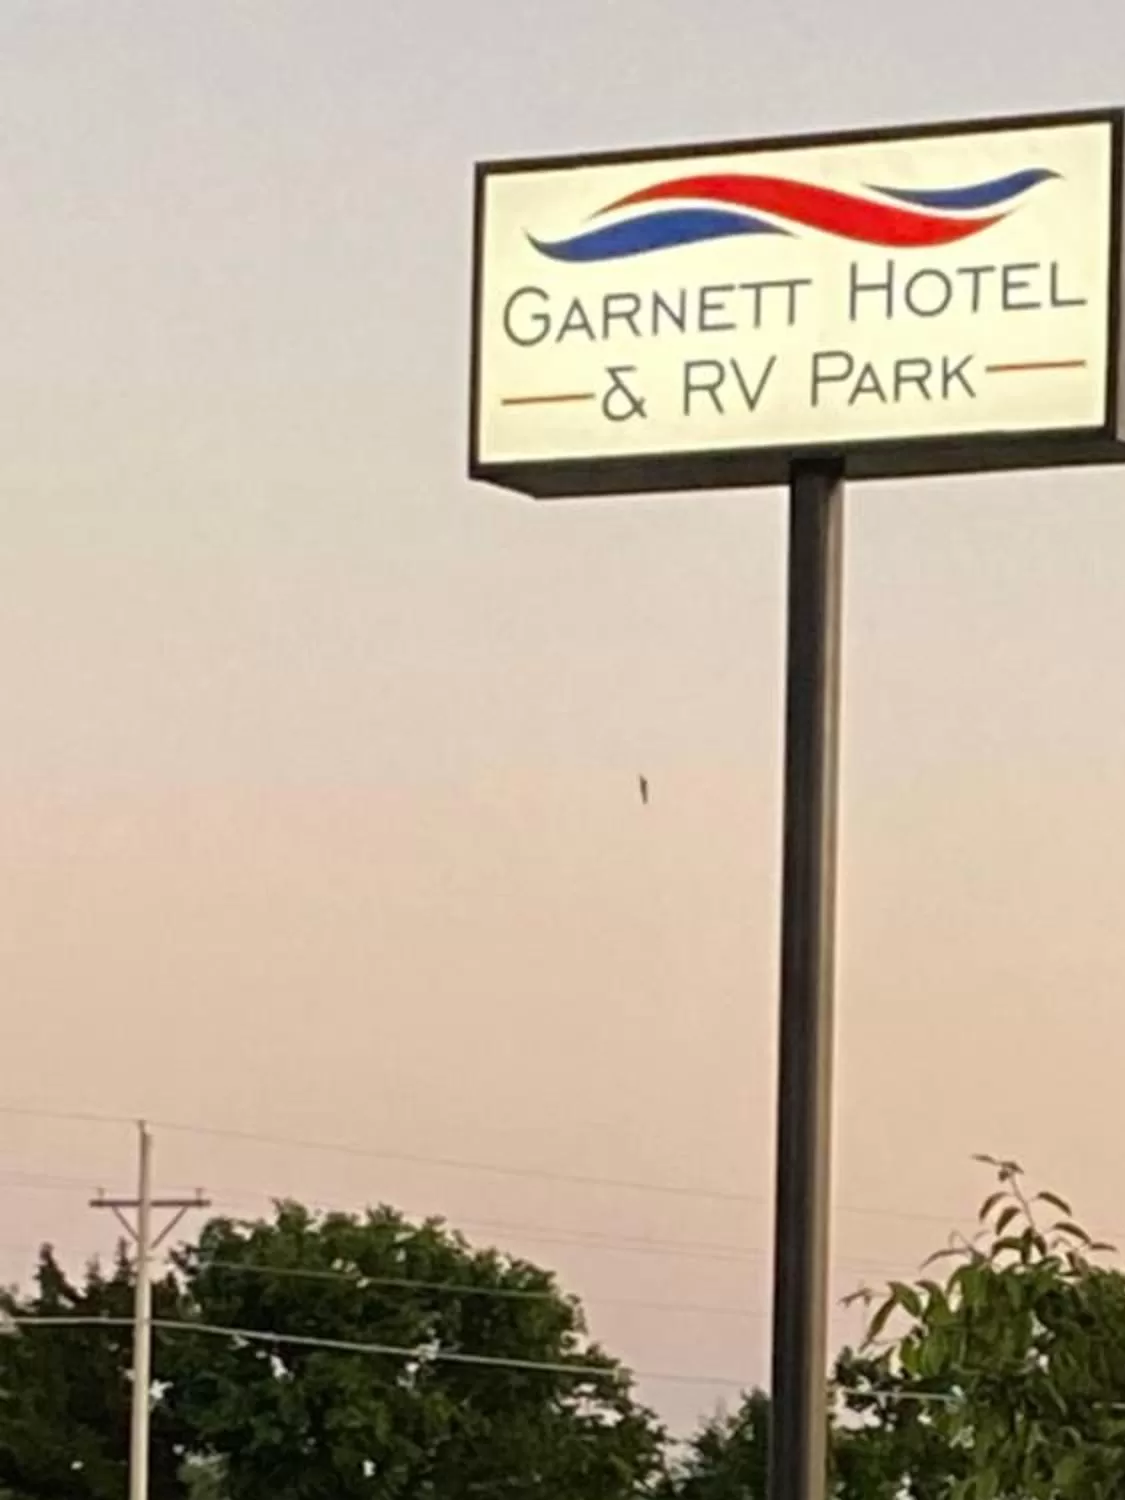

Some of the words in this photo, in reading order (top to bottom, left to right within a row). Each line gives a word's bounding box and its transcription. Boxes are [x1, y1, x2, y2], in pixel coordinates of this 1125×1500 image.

[502, 277, 813, 348] GARNETT
[848, 259, 1088, 323] HOTEL
[601, 365, 648, 422] &
[683, 355, 777, 417] RV
[810, 350, 977, 408] PARK
